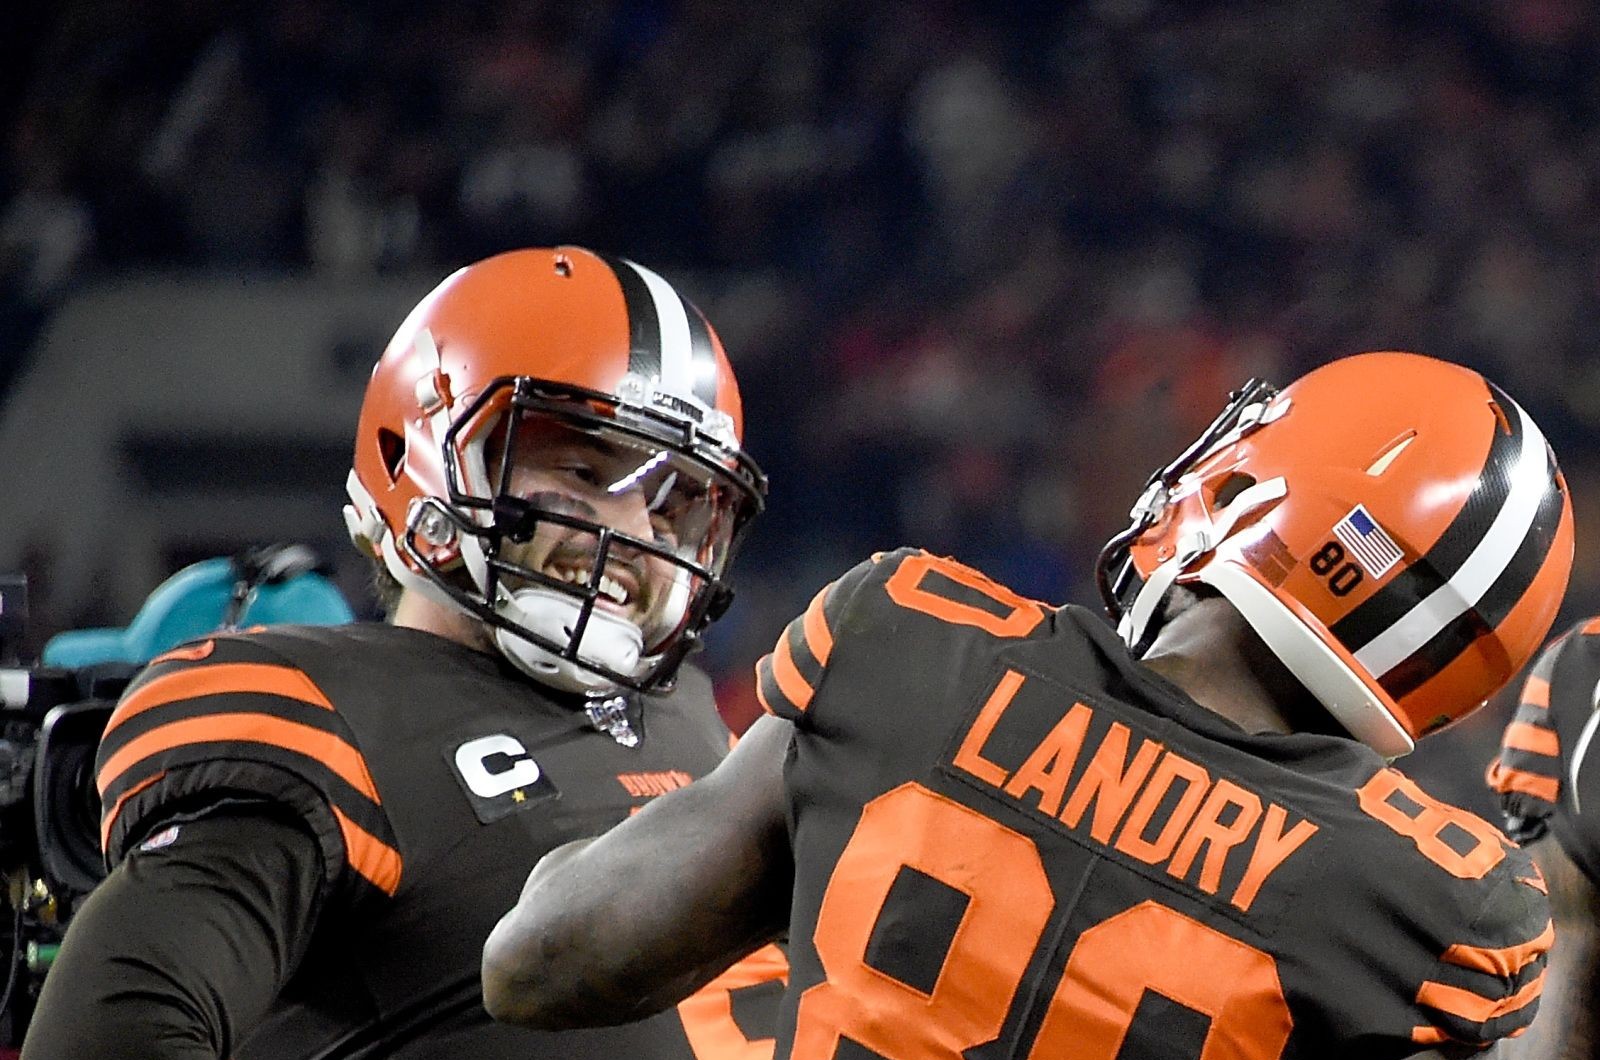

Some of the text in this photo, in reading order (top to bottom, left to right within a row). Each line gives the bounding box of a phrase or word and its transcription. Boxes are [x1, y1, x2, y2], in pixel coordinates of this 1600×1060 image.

[1309, 540, 1364, 597] 80
[455, 734, 540, 798] C
[952, 669, 1320, 913] LANDRY
